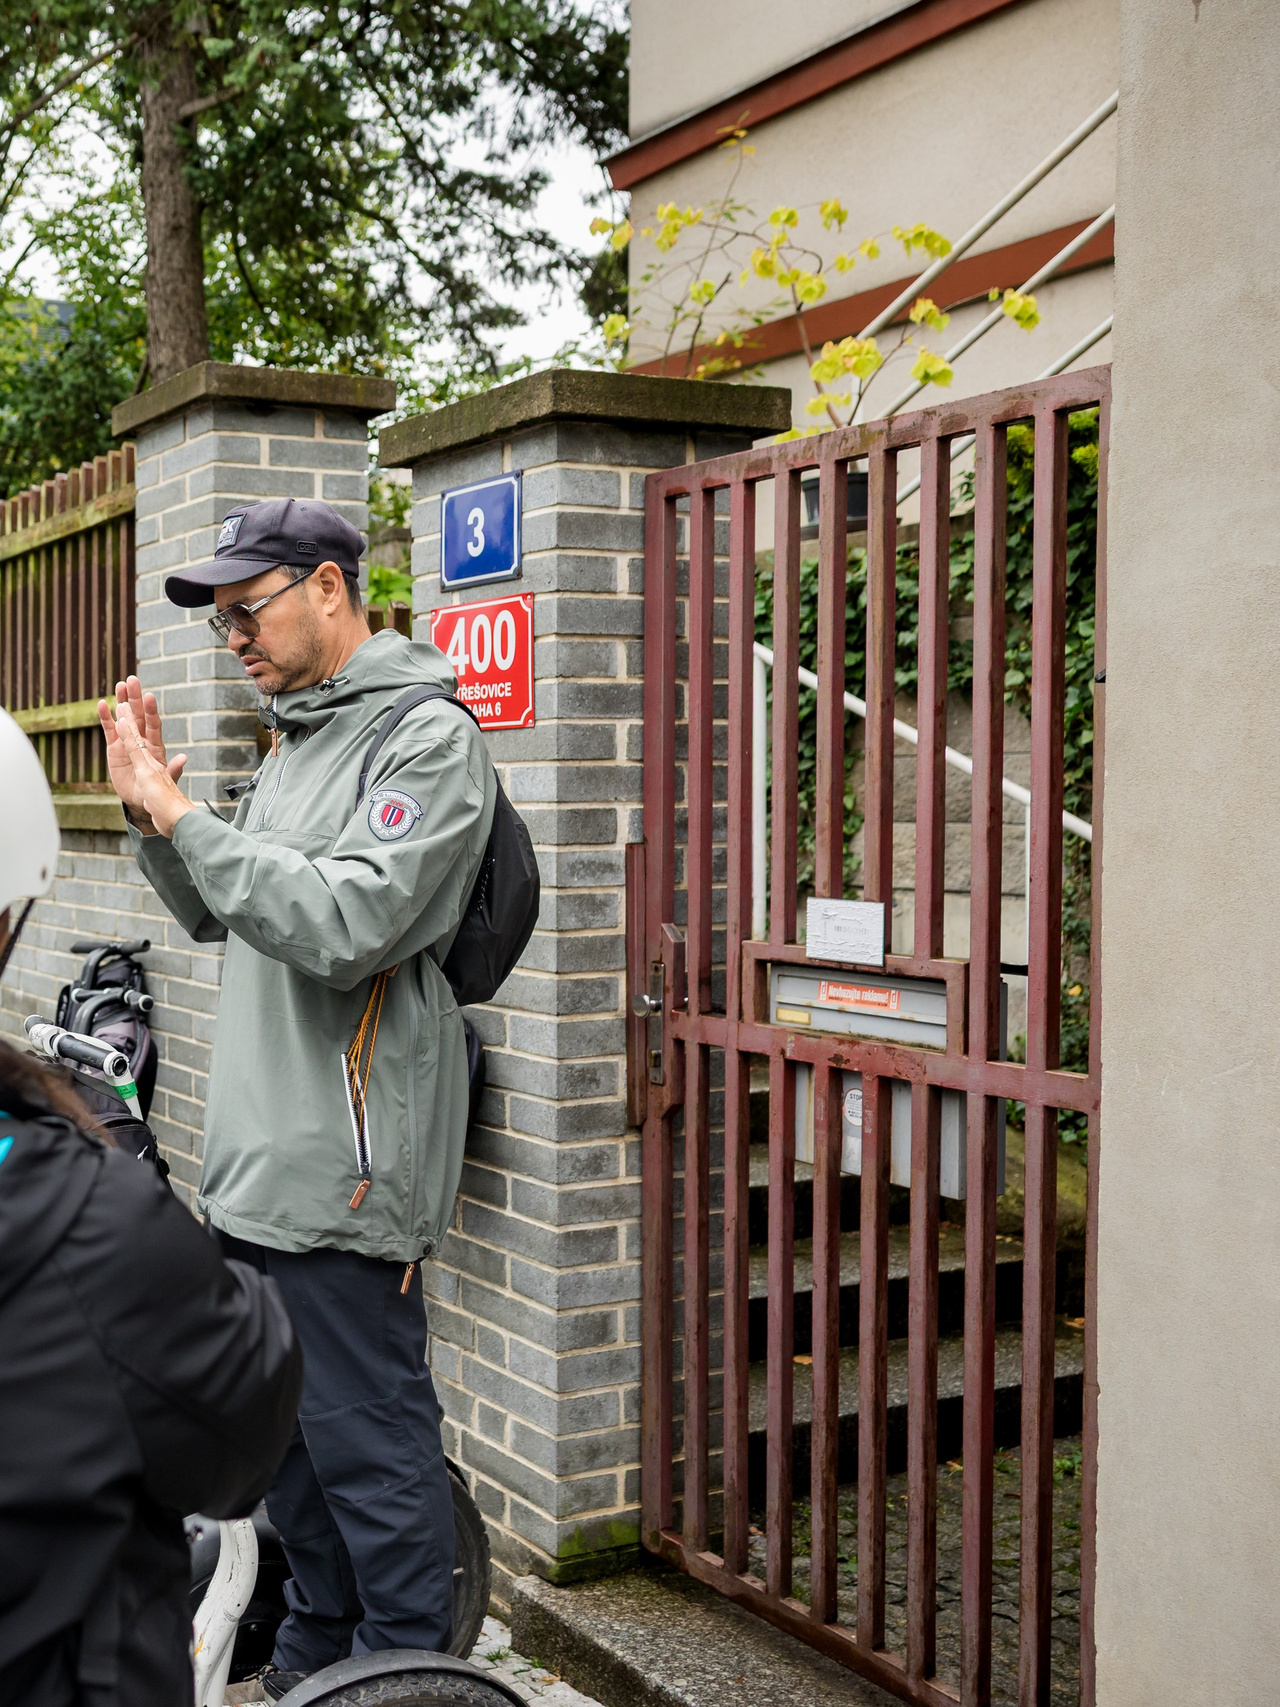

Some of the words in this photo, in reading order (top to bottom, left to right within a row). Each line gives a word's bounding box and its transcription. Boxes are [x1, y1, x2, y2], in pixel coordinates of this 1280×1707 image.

[467, 507, 485, 557] 3
[446, 610, 516, 676] 400
[453, 682, 512, 701] TŘEŠOVICE
[495, 702, 502, 717] 6
